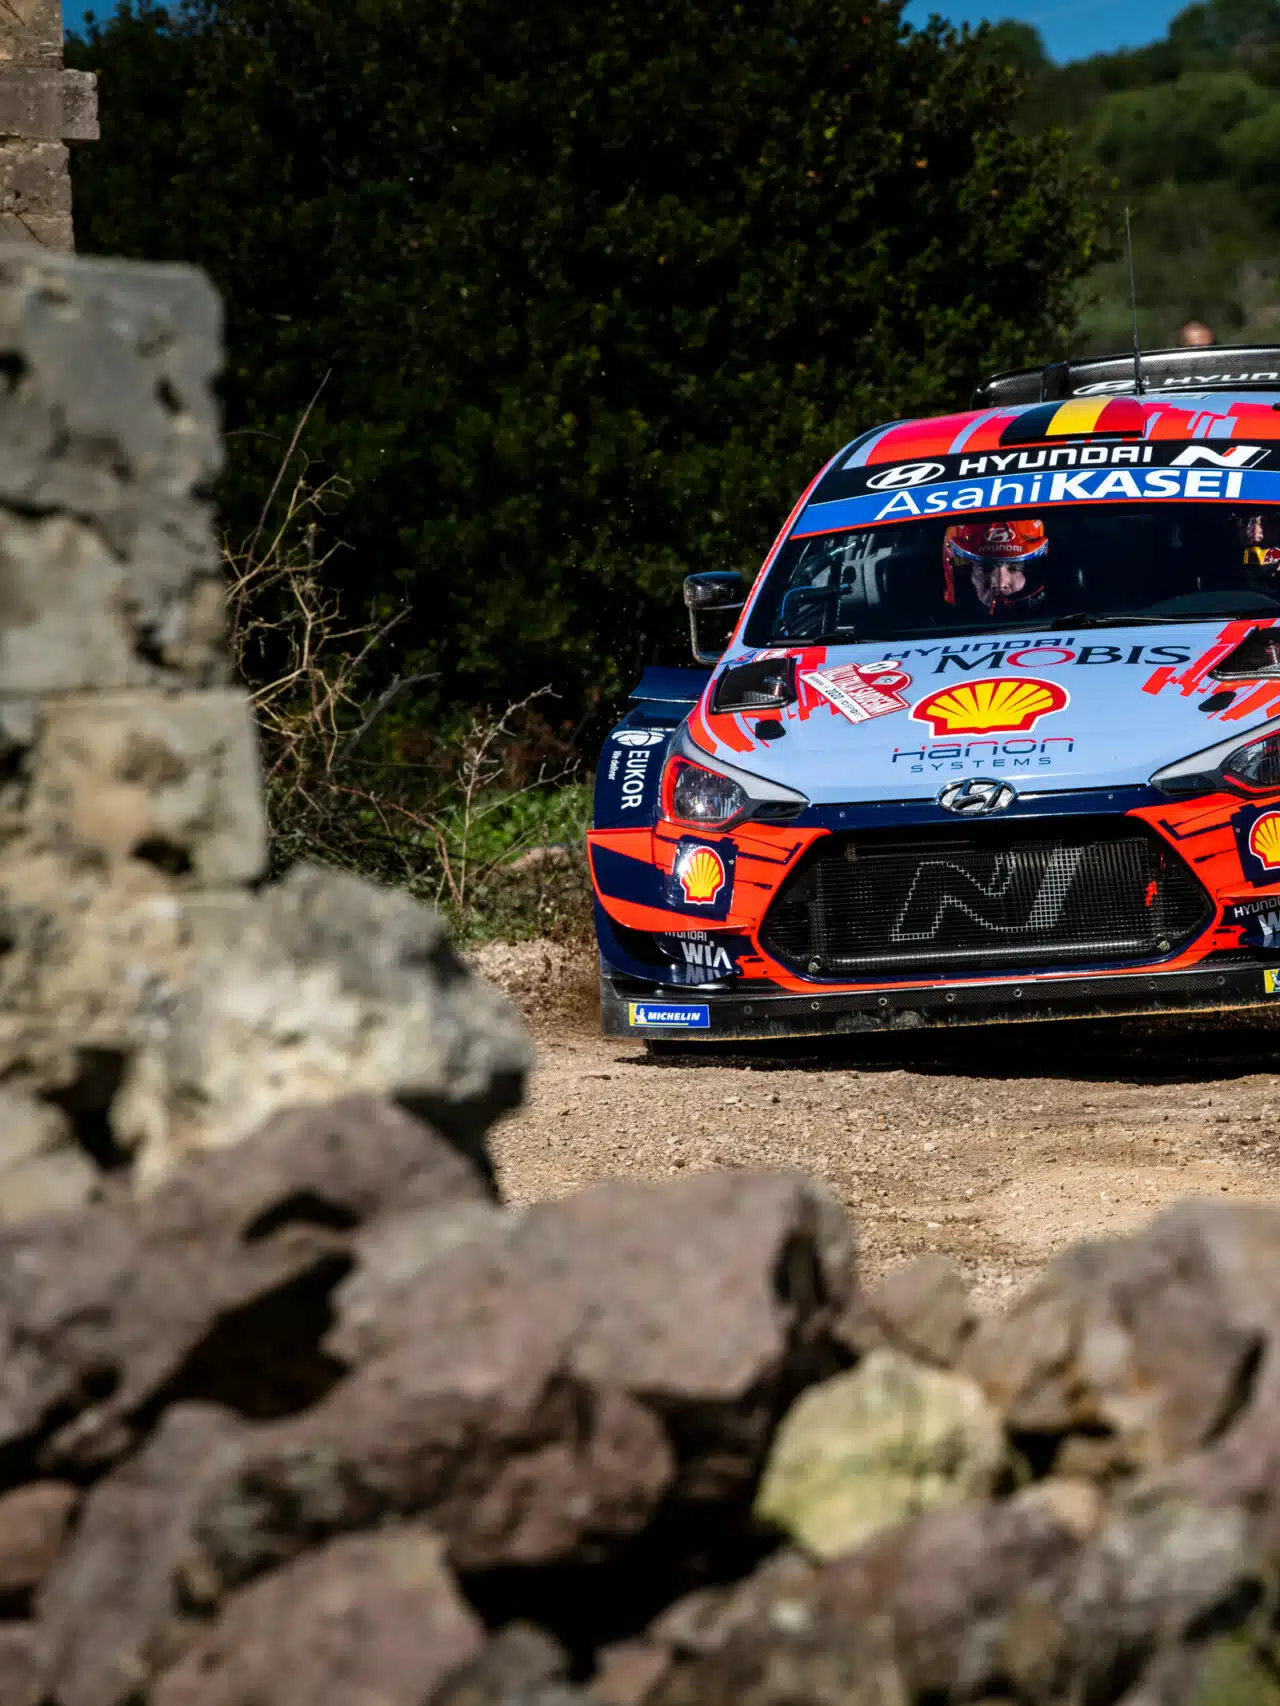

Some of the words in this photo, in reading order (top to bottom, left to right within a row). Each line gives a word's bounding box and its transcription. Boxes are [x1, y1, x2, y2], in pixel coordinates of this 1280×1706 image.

[958, 446, 1153, 476] HYUNDAI
[883, 637, 1076, 661] HYUNDAI
[931, 645, 1191, 674] MOBIS
[911, 757, 1052, 773] SYSTEMS
[620, 750, 650, 810] EUKOR
[648, 1011, 701, 1021] MICHELIN
